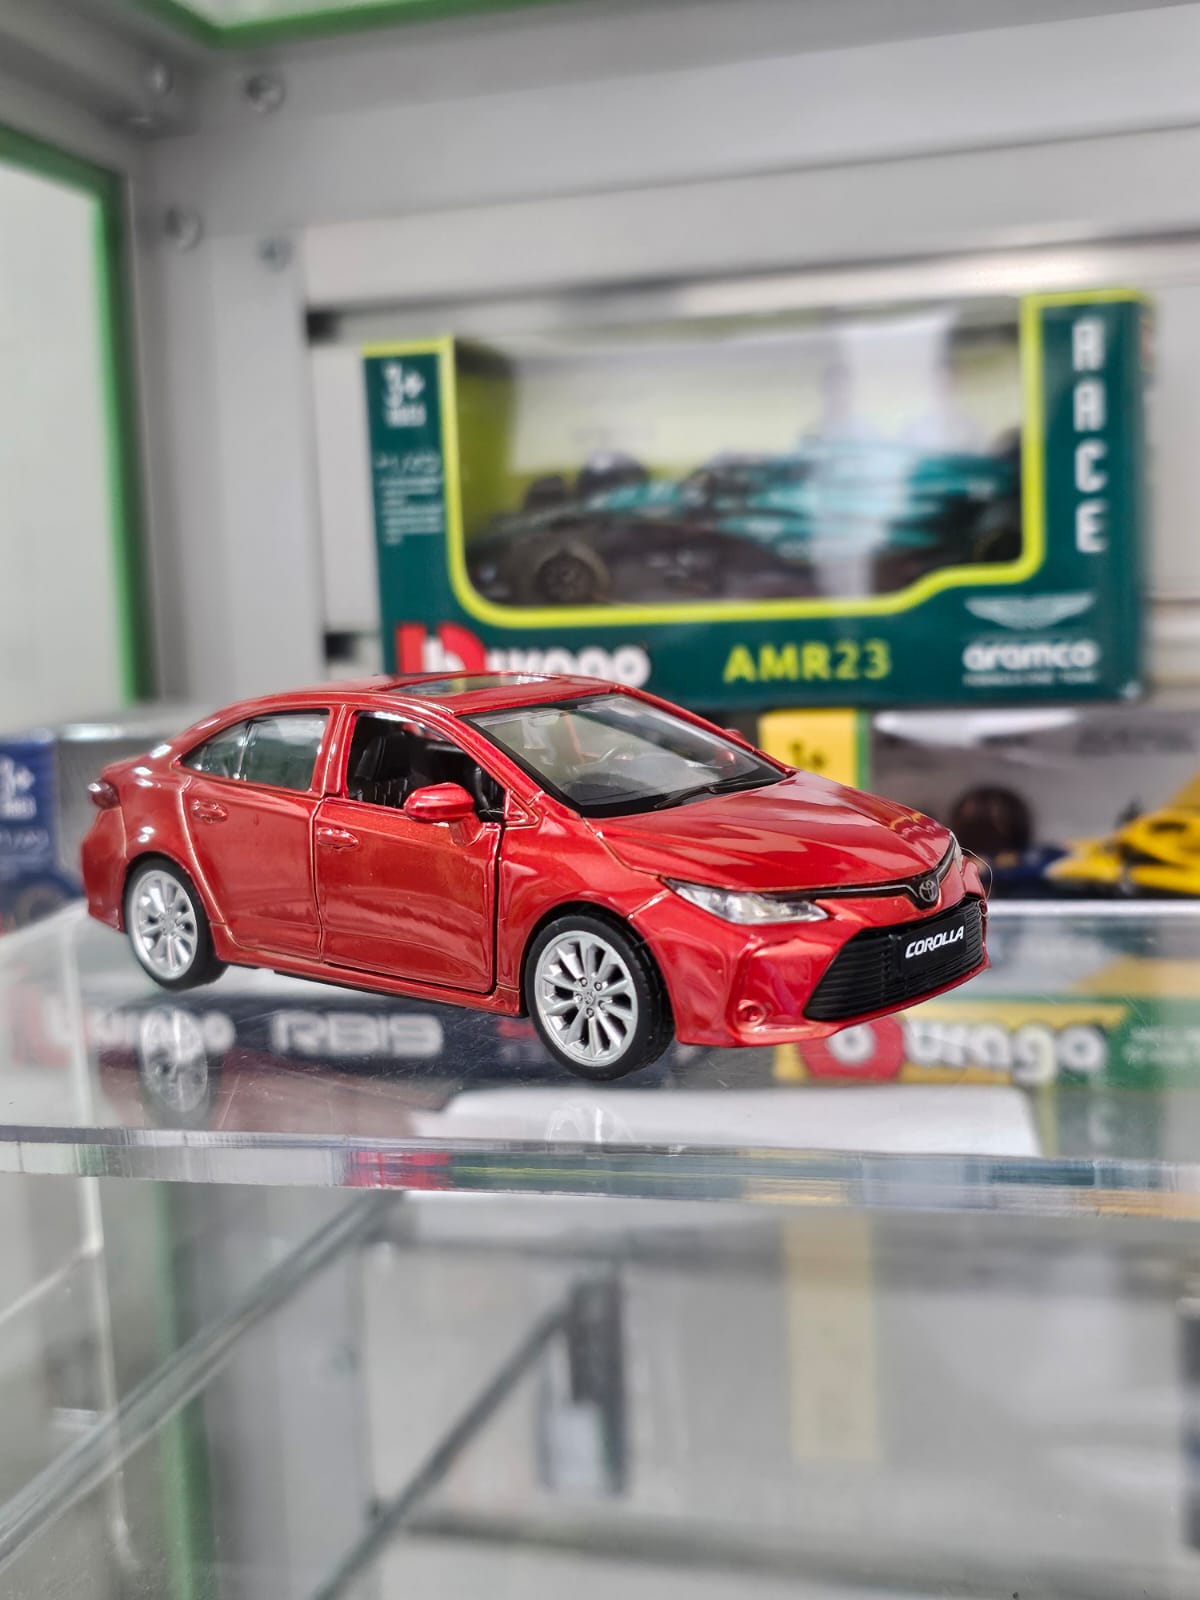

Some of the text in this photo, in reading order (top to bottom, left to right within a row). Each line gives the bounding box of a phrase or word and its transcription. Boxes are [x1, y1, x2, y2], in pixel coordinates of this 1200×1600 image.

[723, 640, 892, 684] AMR23
[962, 640, 1099, 671] aramco
[904, 925, 965, 959] COROLLA
